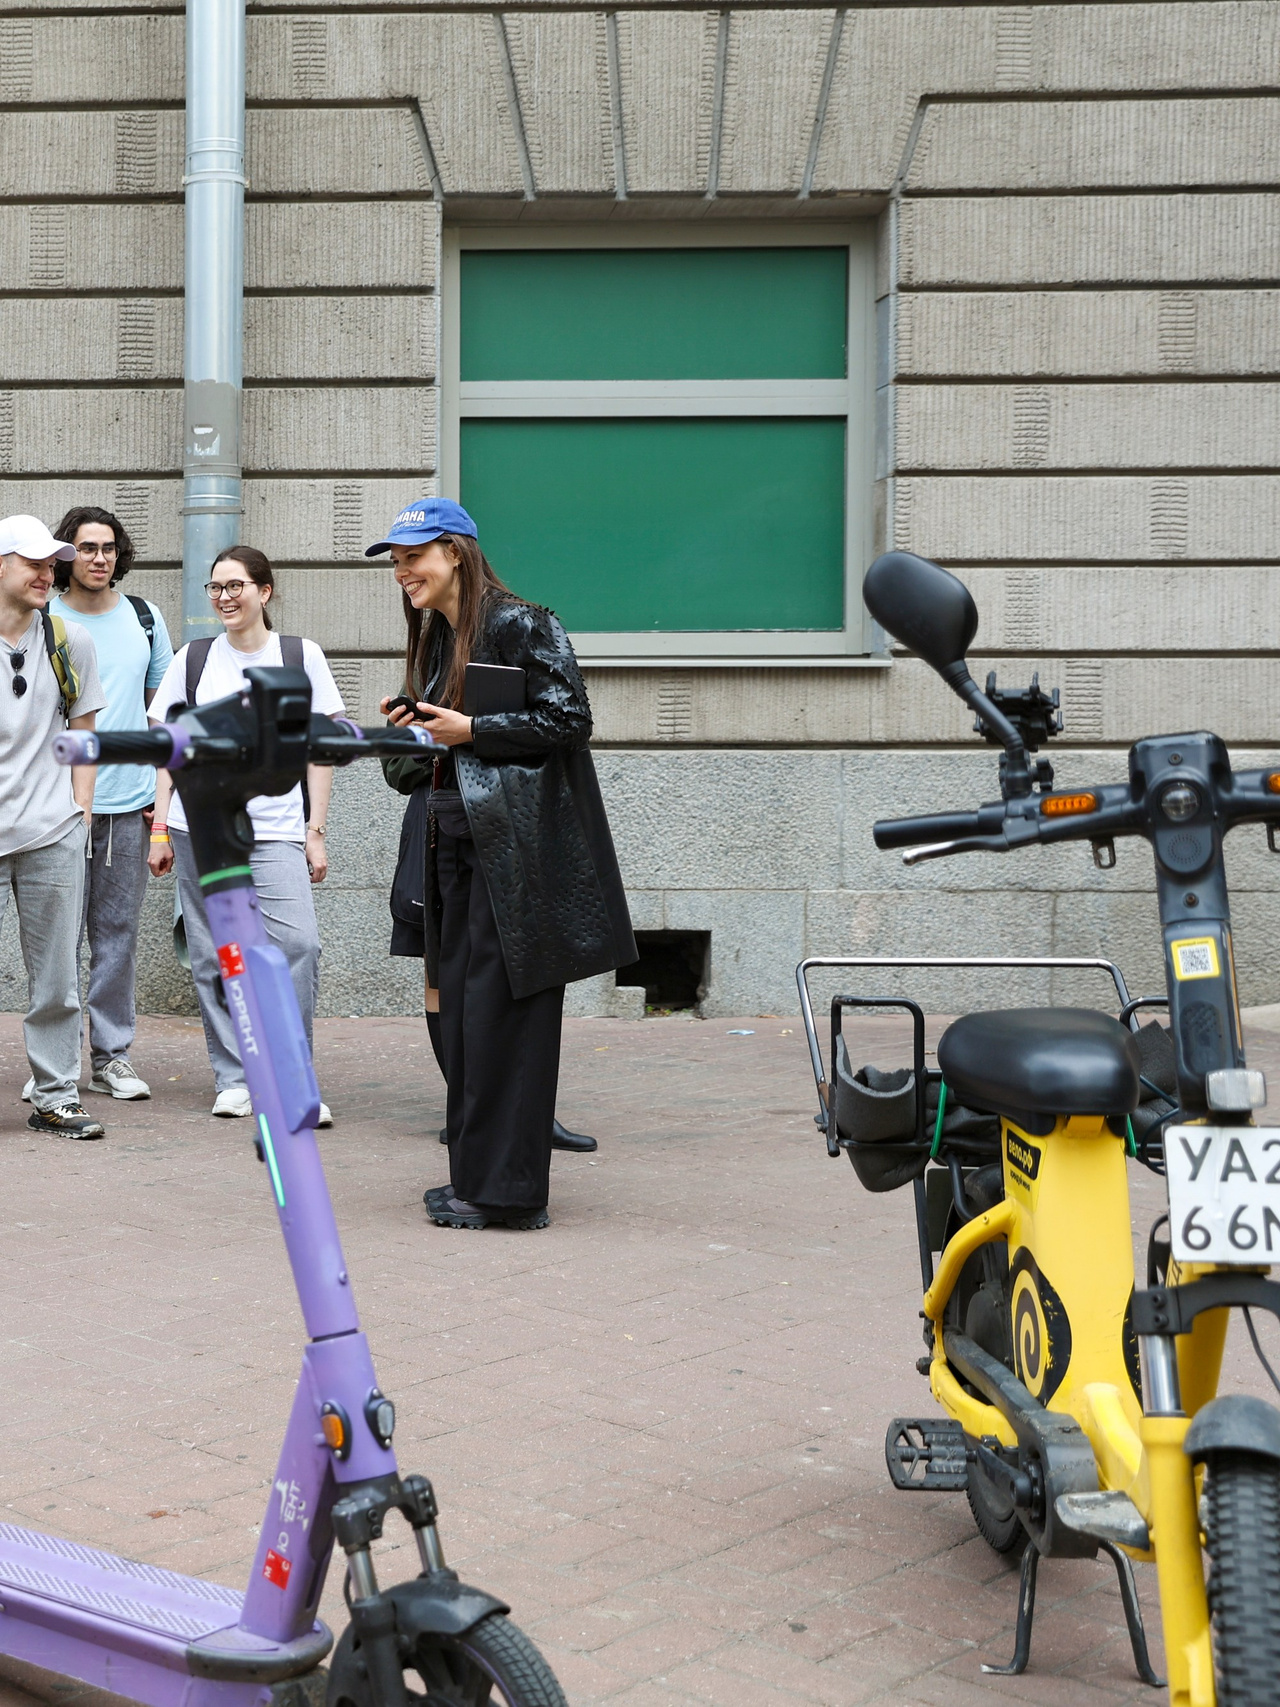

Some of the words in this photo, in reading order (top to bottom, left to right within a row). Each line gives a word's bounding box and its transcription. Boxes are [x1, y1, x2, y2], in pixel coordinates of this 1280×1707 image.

[392, 510, 425, 525] MAHA
[230, 979, 259, 1056] ЮРЕНТ
[276, 1479, 300, 1553] ЮЕНТ
